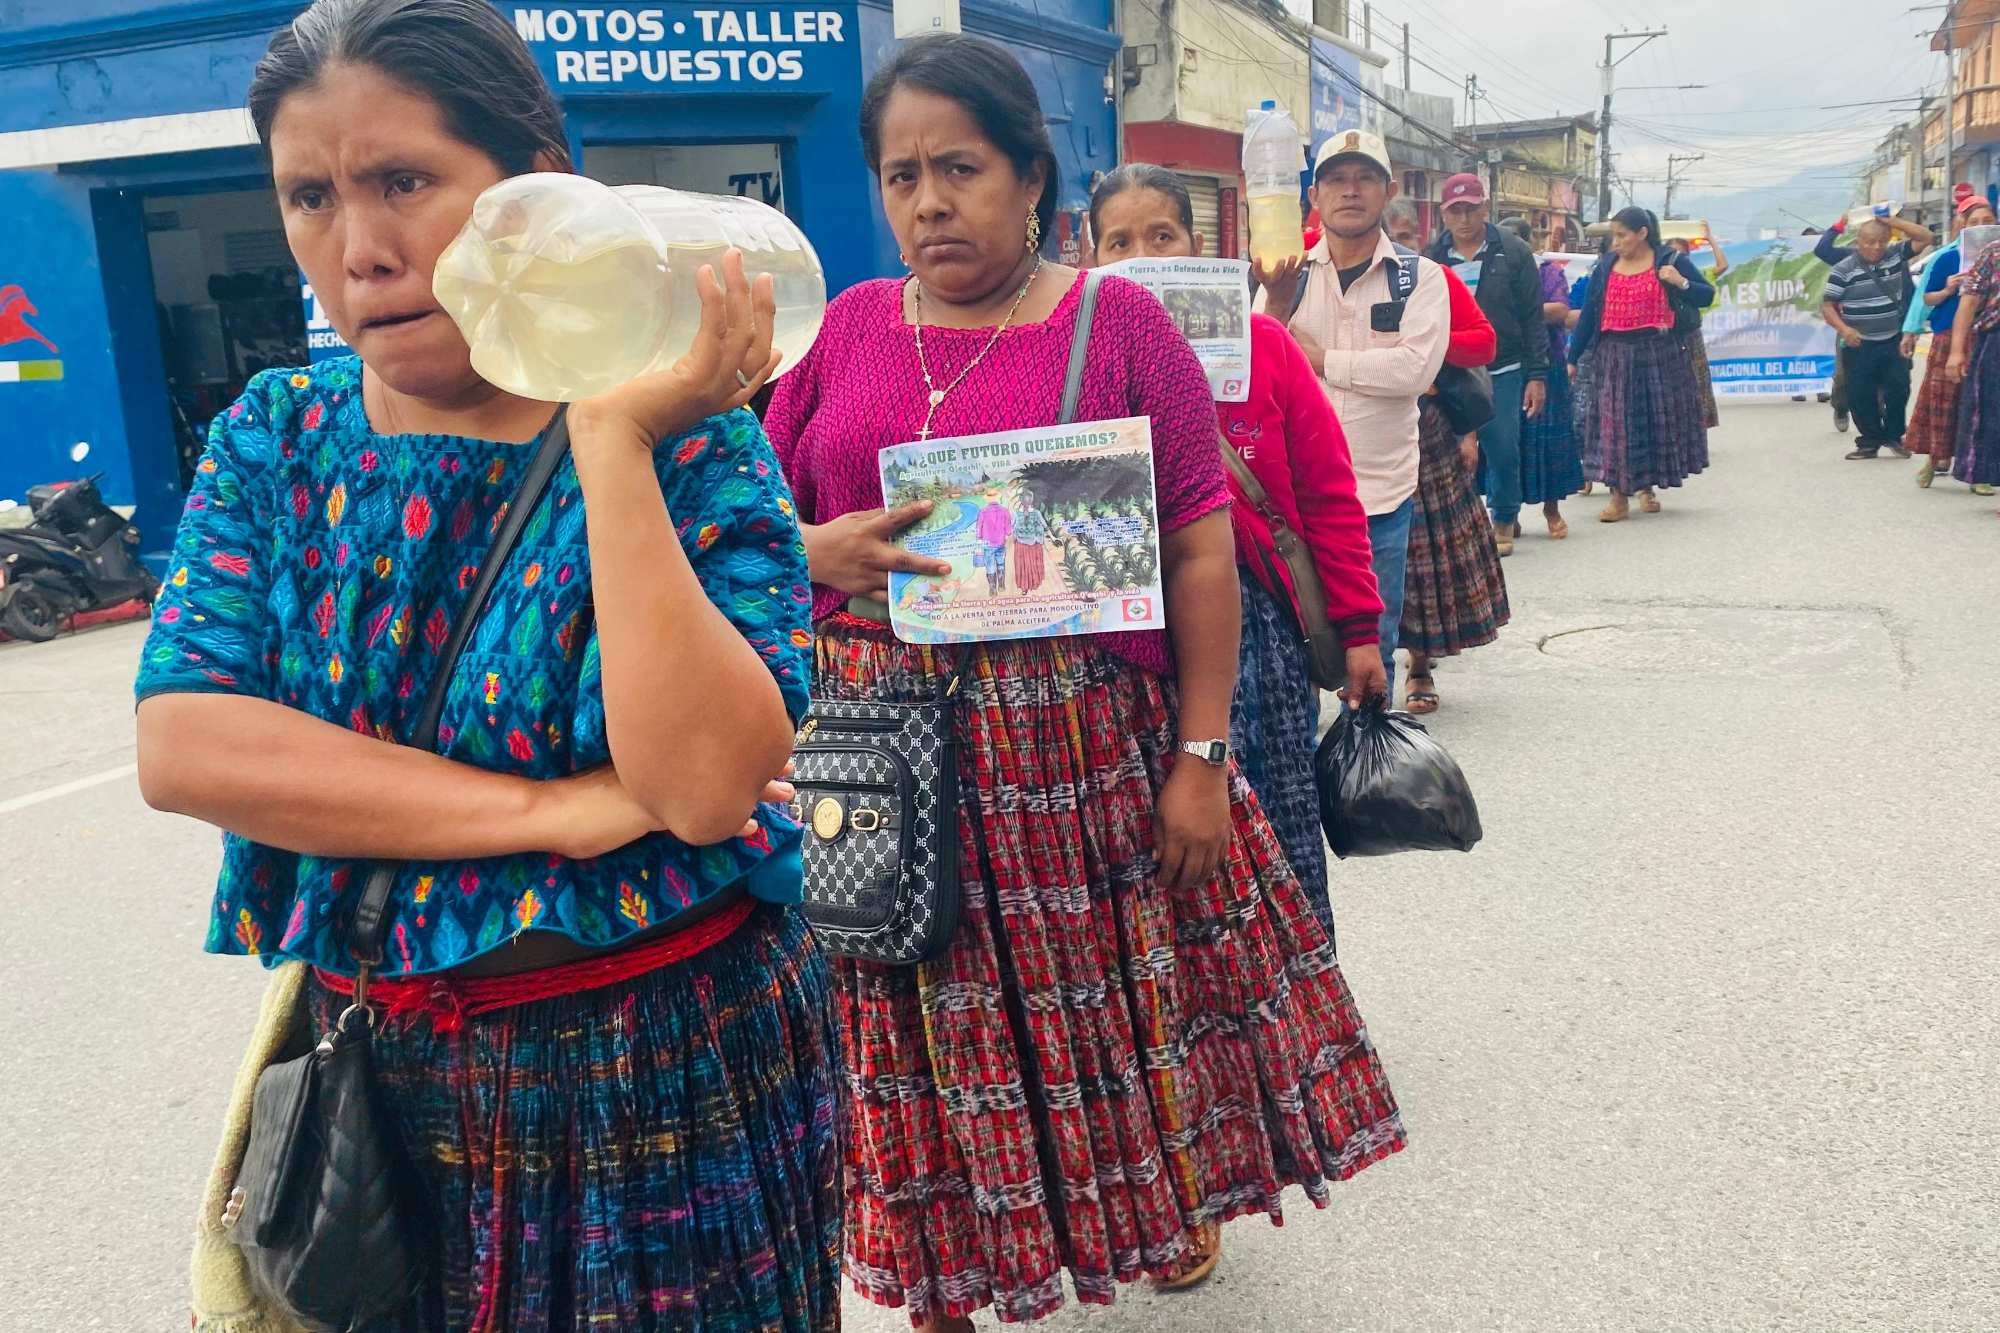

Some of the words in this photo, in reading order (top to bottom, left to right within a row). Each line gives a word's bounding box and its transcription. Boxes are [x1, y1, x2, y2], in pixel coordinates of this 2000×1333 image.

[514, 9, 664, 42] MOTOS
[693, 10, 844, 42] TALLER
[556, 50, 804, 83] REPUESTOS
[1736, 282, 1760, 304] ES
[1765, 362, 1785, 376] DEL
[1788, 360, 1817, 374] AGUA
[961, 442, 1020, 460] FUTURO
[1025, 432, 1118, 454] QUEREMOS?
[999, 608, 1027, 616] TIERRAS
[1050, 603, 1099, 612] MONOCULTIVO
